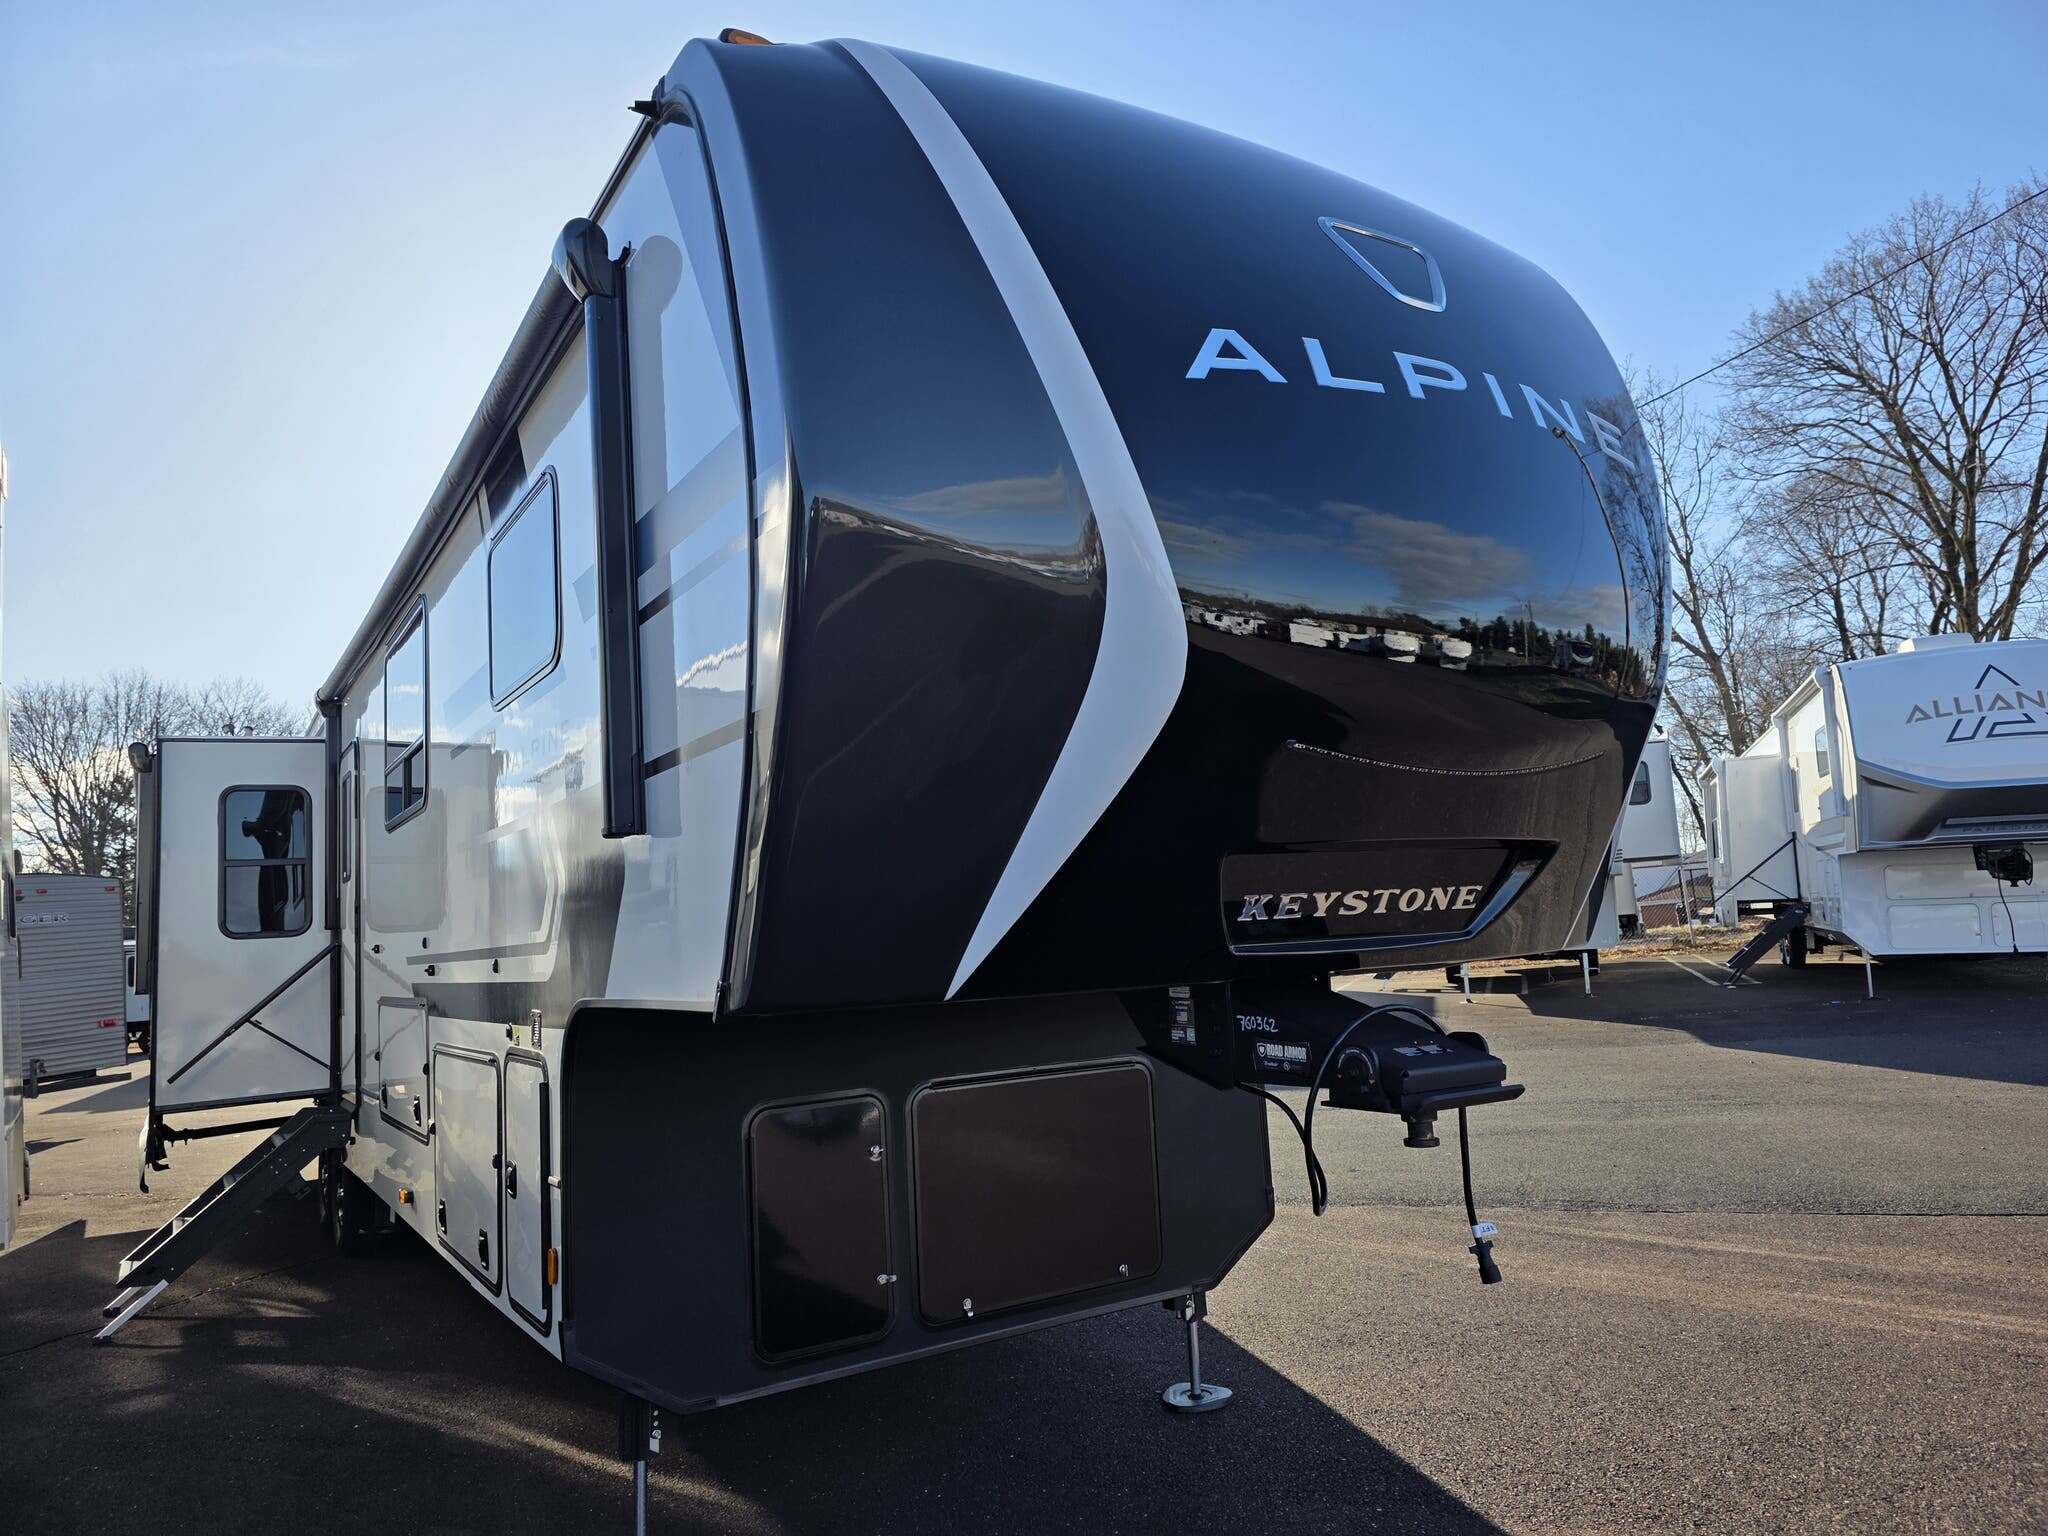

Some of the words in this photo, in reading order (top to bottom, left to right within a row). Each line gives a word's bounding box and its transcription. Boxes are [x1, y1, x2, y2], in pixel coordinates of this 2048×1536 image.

[1185, 328, 1636, 470] ALPINE
[1906, 689, 2048, 725] ALLIAN
[1237, 884, 1483, 922] KEYSTONE
[1236, 1014, 1279, 1033] 760362
[1266, 1043, 1284, 1057] ROAD
[1284, 1045, 1307, 1061] ARMOR
